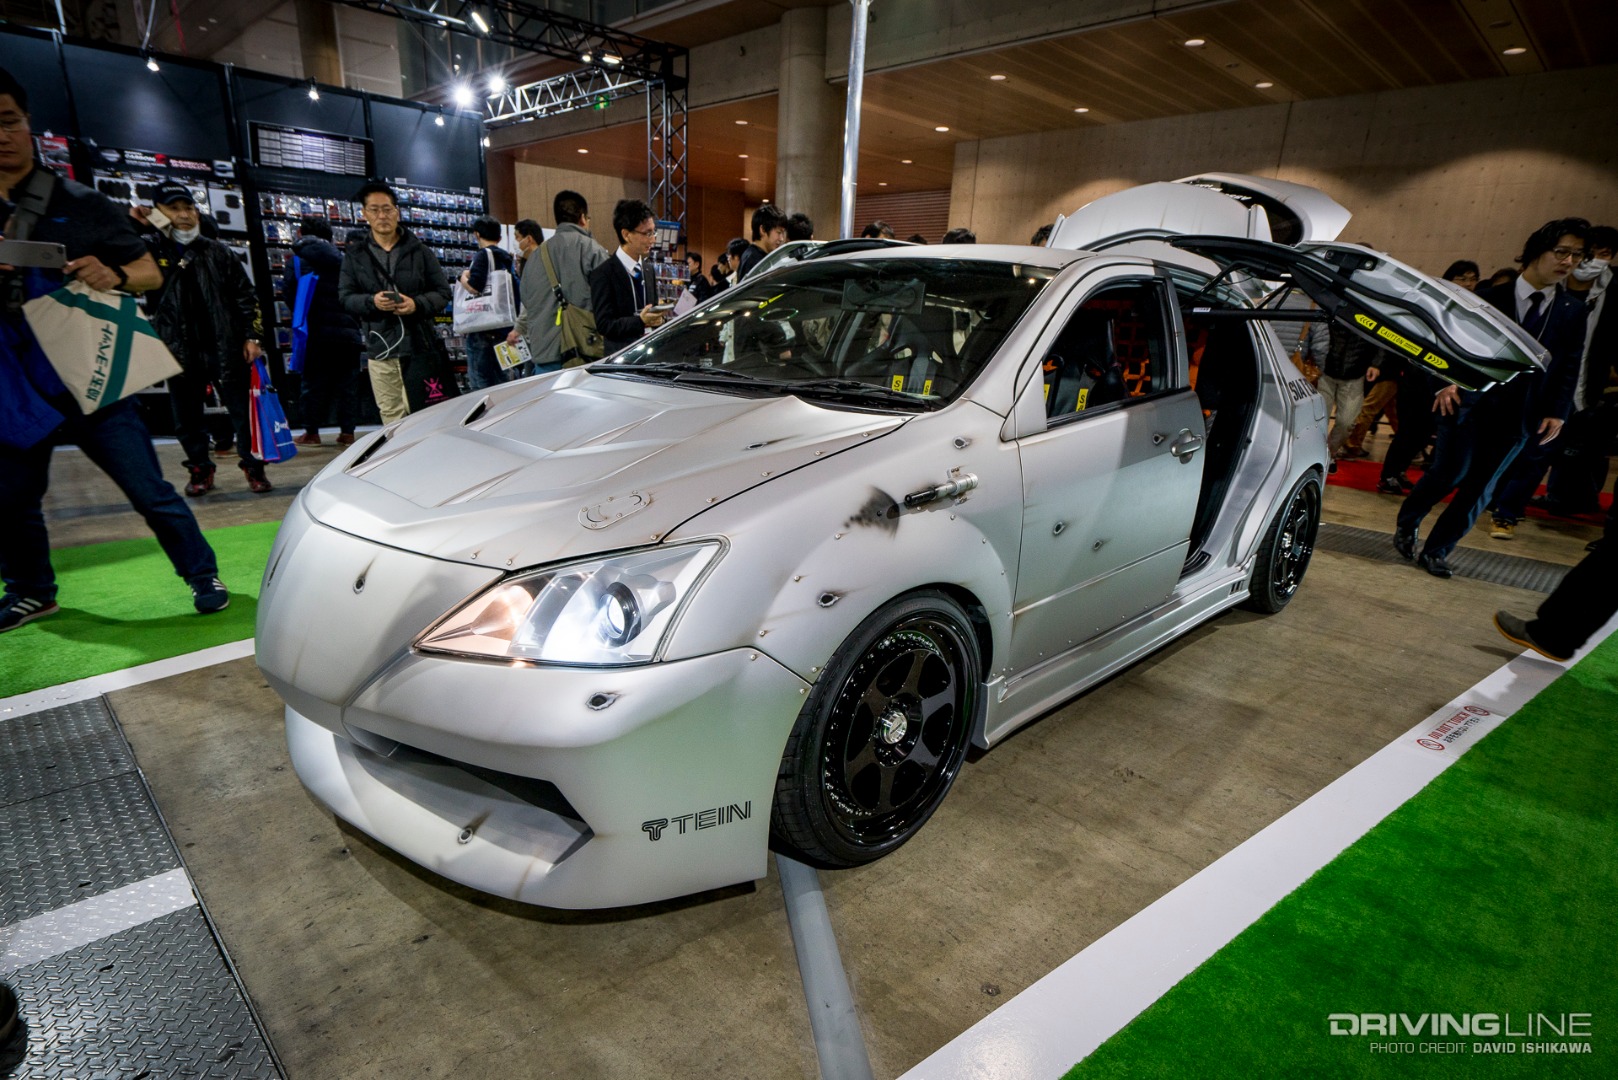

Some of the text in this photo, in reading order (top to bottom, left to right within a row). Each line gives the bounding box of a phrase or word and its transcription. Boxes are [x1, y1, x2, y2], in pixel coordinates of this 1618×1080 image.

[1380, 328, 1404, 345] CAUTION
[85, 324, 113, 402] 埼玉トヨペット
[671, 800, 751, 835] TEIN
